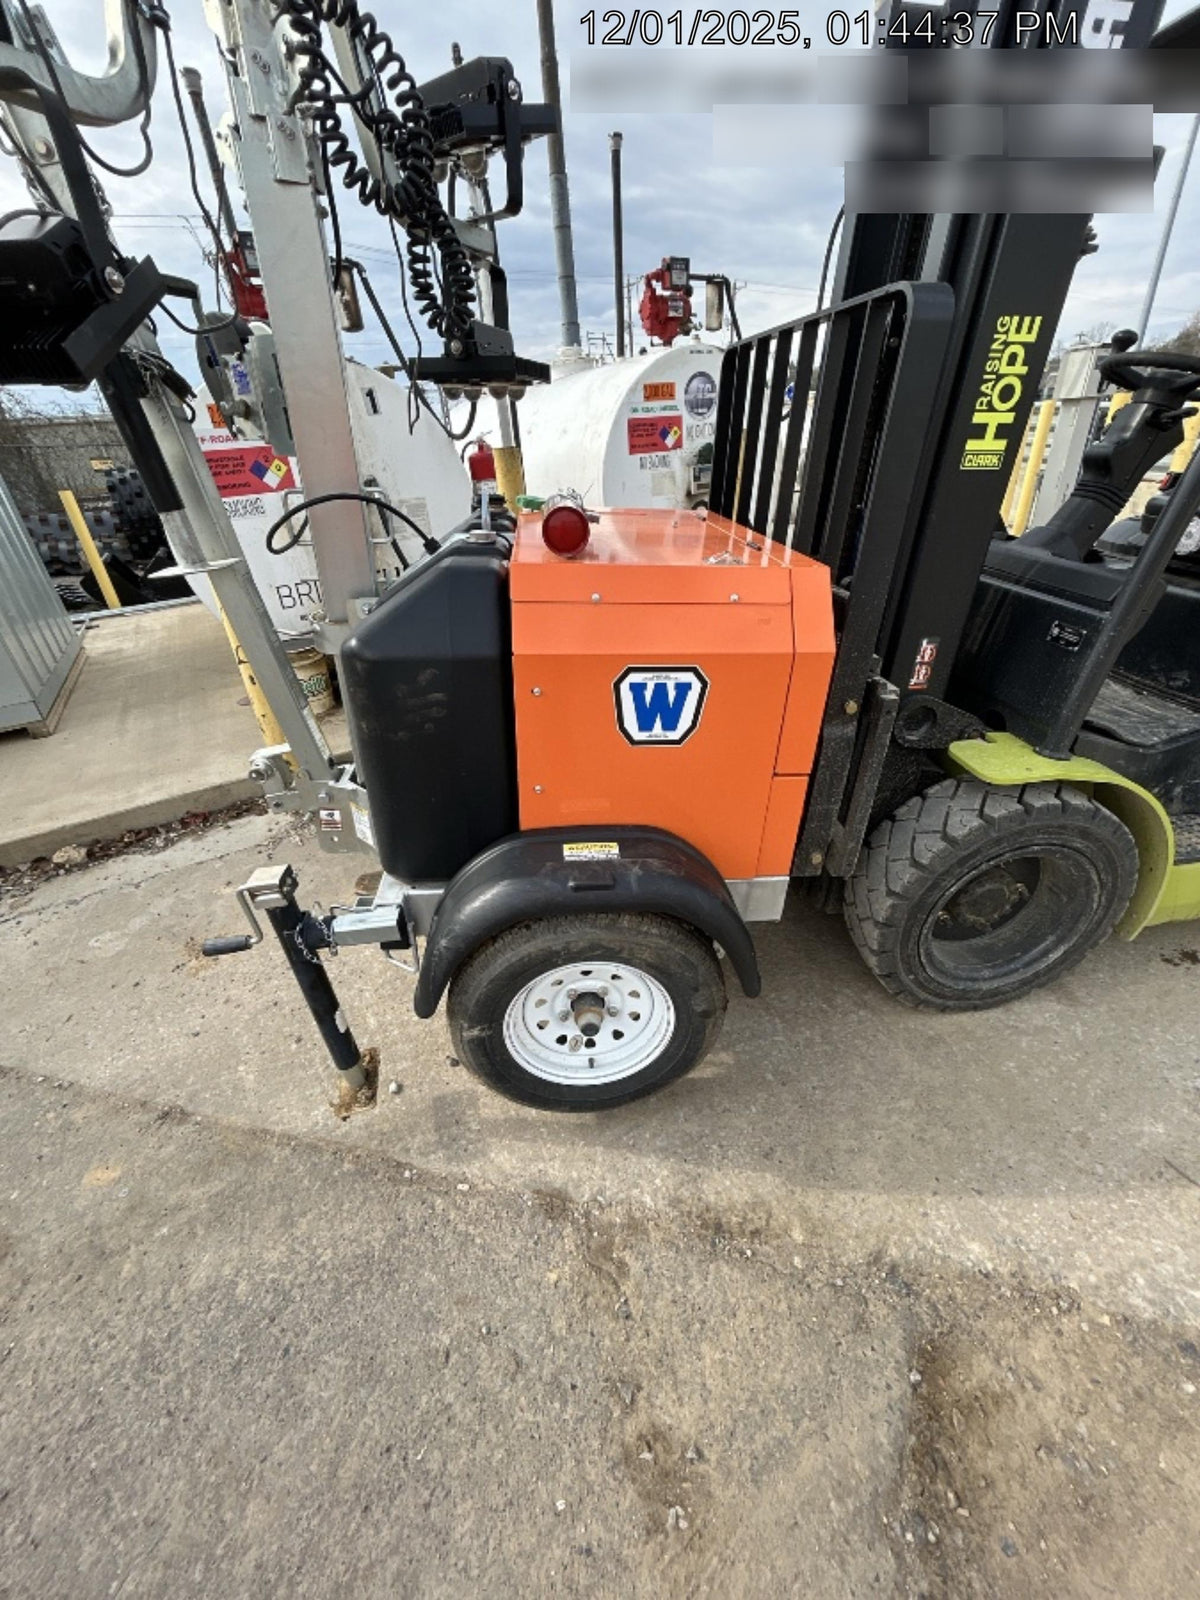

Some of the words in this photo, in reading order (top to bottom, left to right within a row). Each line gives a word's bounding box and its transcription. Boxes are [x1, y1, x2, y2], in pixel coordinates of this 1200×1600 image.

[965, 316, 1043, 450] HOPE
[976, 316, 1010, 409] RAISING
[365, 388, 379, 414] 1
[962, 454, 1001, 467] CLARK
[629, 682, 692, 732] W
